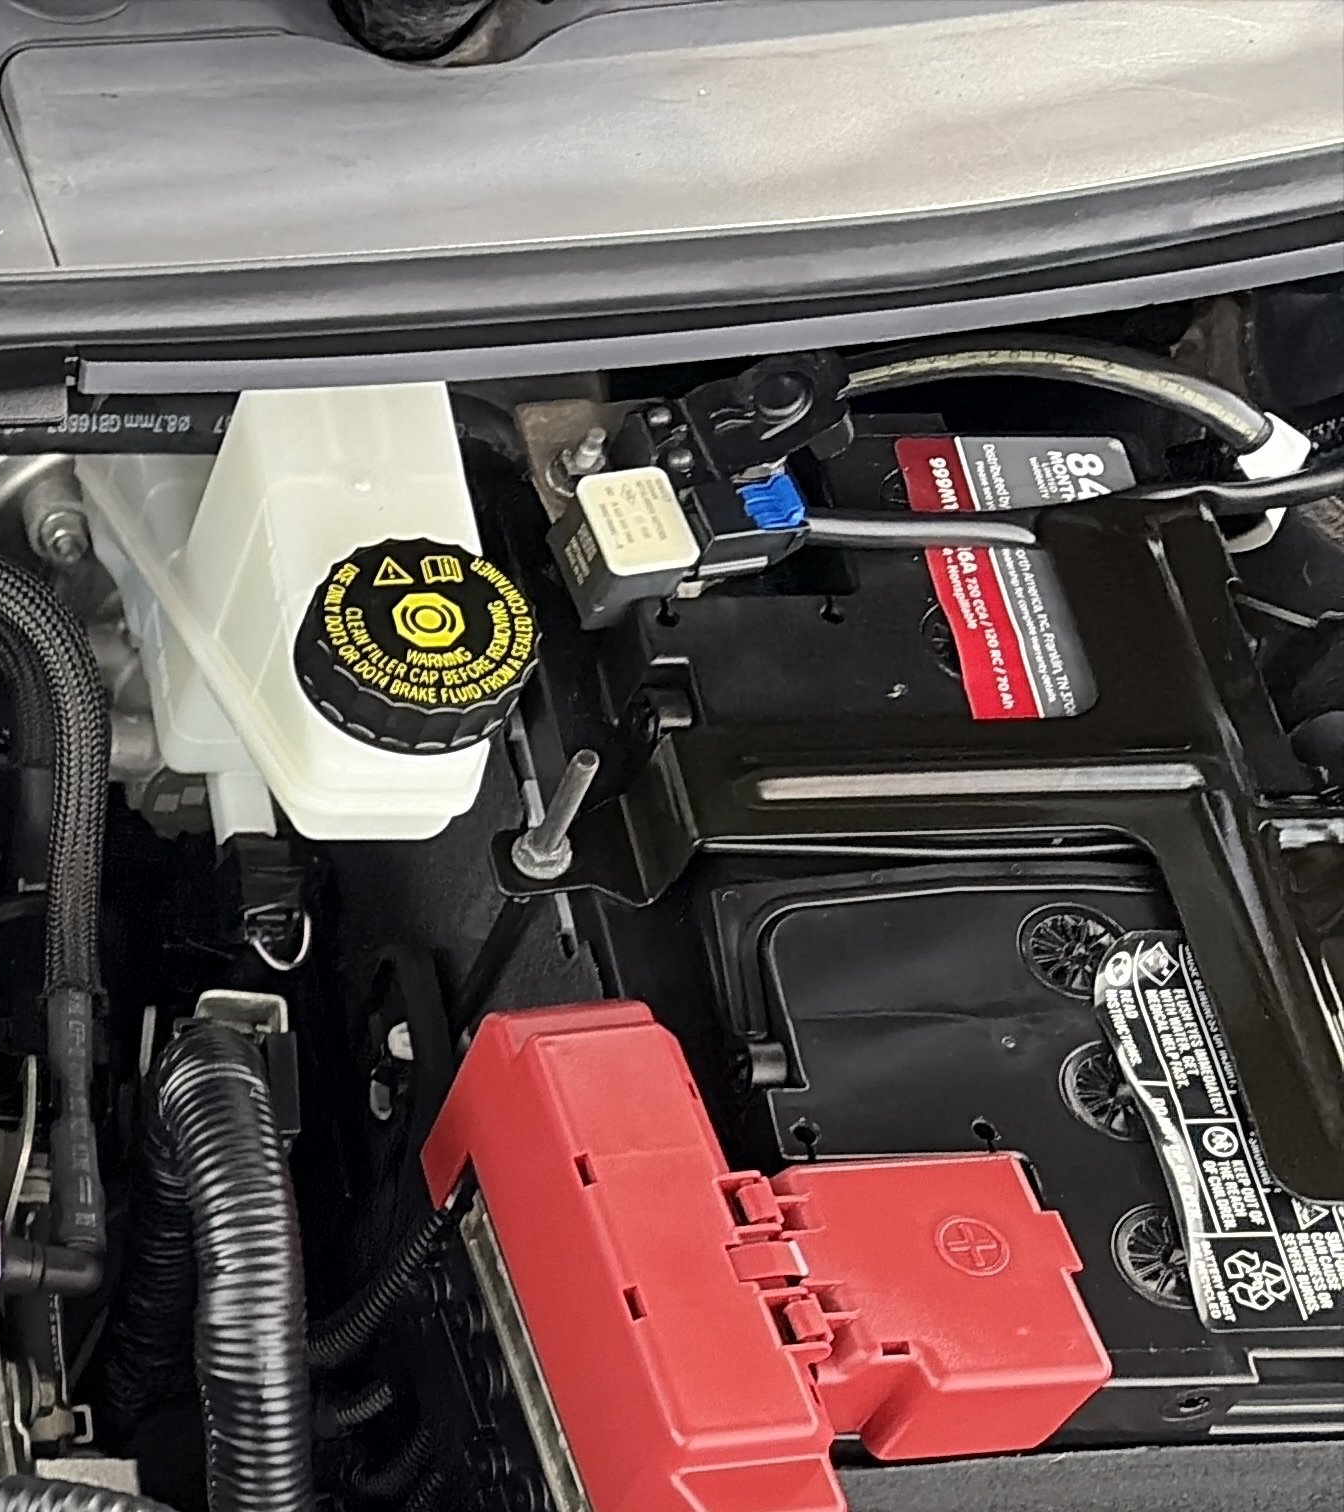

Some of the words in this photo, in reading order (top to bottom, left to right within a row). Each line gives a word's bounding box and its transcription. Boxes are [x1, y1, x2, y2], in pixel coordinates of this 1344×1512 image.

[982, 444, 1009, 495] Distributed
[1063, 453, 1111, 500] 84
[333, 563, 360, 586] USE
[470, 557, 529, 614] CONTAINER
[965, 577, 981, 597] 720
[323, 584, 346, 612] ONLY
[947, 565, 977, 629] Nonspillable
[1015, 587, 1024, 598] for
[973, 599, 988, 619] CCA
[1018, 600, 1037, 635] complete
[345, 607, 371, 648] CLEAN
[362, 642, 408, 679] FILLER
[410, 668, 439, 686] CAP
[442, 655, 496, 686] BEFORE
[486, 599, 511, 661] REMOVING
[512, 616, 533, 661] SEALED
[985, 628, 999, 648] 120
[339, 644, 361, 665] OR
[406, 647, 472, 668] WARNING
[511, 657, 524, 670] A
[990, 650, 1004, 665] RC
[1031, 636, 1047, 674] warranty
[353, 659, 390, 688] DOT4
[480, 664, 518, 695] FROM
[996, 675, 1009, 690] 70
[1056, 675, 1069, 689] TN
[389, 681, 438, 703] BRAKE
[440, 686, 482, 704] FLUID
[1000, 693, 1014, 709] Ah
[1119, 990, 1138, 1018] READ
[1173, 989, 1194, 1021] FLUSH
[1145, 989, 1169, 1033] MEDICAL
[1160, 1034, 1180, 1060] HELP
[1159, 990, 1177, 1015] WITH
[1182, 1056, 1199, 1075] GET
[1184, 1024, 1203, 1047] EYES
[1193, 1049, 1228, 1115] IMMEDIATELY
[1202, 1161, 1218, 1174] OF
[1217, 1161, 1234, 1180] THE
[1231, 1160, 1251, 1186] KEEP
[1225, 1182, 1247, 1217] REACH
[1241, 1188, 1259, 1207] OUT
[1249, 1208, 1265, 1225] OF
[1282, 1233, 1306, 1273] SEVERE
[1311, 1232, 1328, 1254] CAN
[1199, 1242, 1225, 1289] BATTERY
[1217, 1291, 1236, 1321] MUST
[1296, 1233, 1327, 1291] BLINDNESS
[1317, 1292, 1333, 1308] OR
[1319, 1256, 1341, 1290] CAUSE
[1193, 1261, 1221, 1319] RECYCLED
